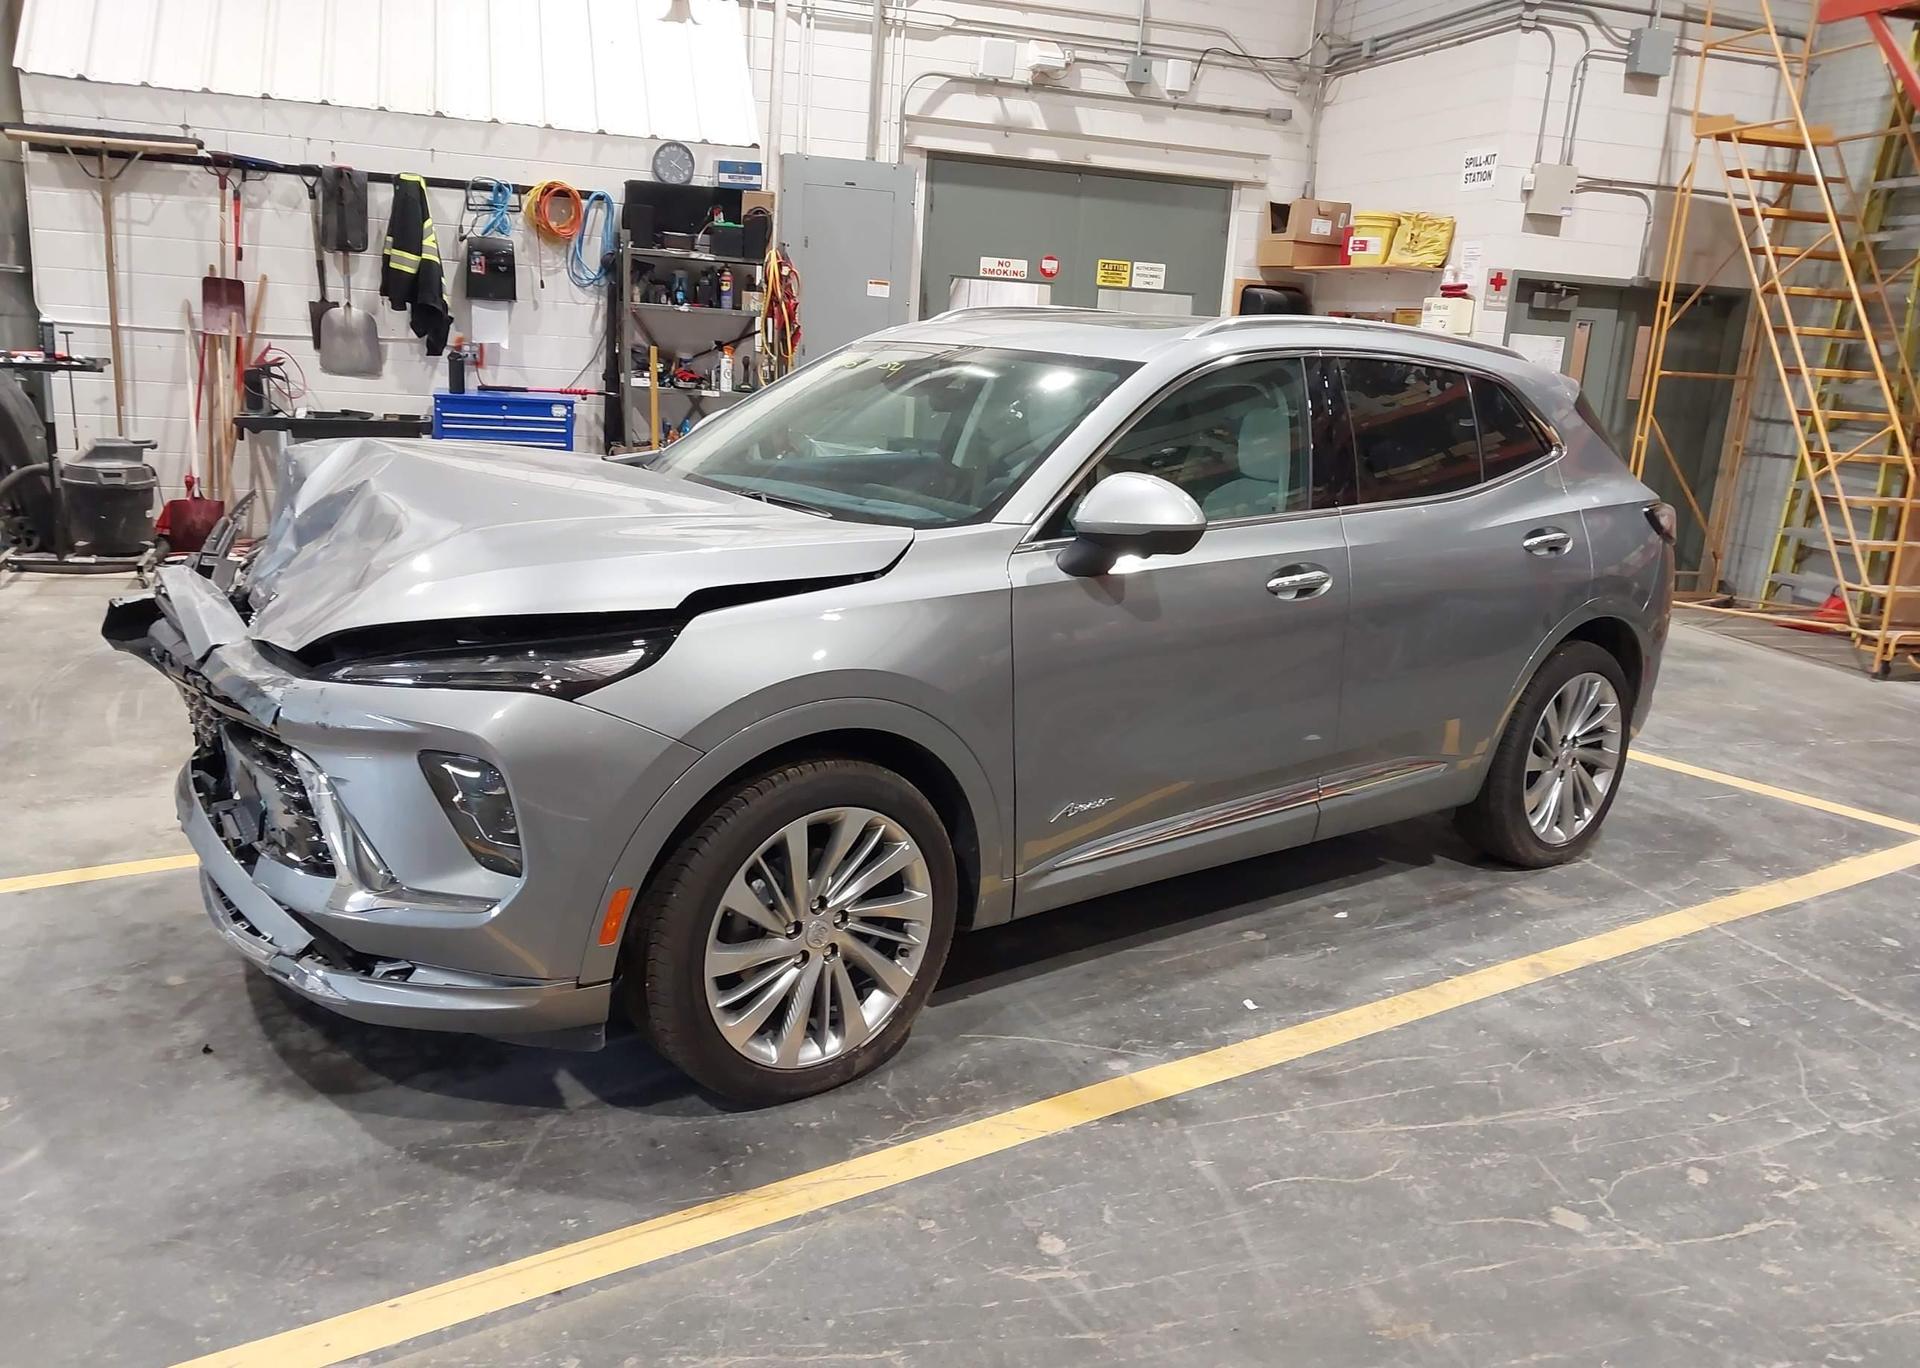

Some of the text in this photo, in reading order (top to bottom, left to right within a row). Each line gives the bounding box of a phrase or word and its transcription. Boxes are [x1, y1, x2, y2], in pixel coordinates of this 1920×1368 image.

[1464, 153, 1498, 169] SPILL-KIT
[1463, 170, 1493, 184] STATION
[997, 260, 1012, 268] NO
[1101, 263, 1129, 272] CAUTION
[981, 267, 1026, 278] SMOKING
